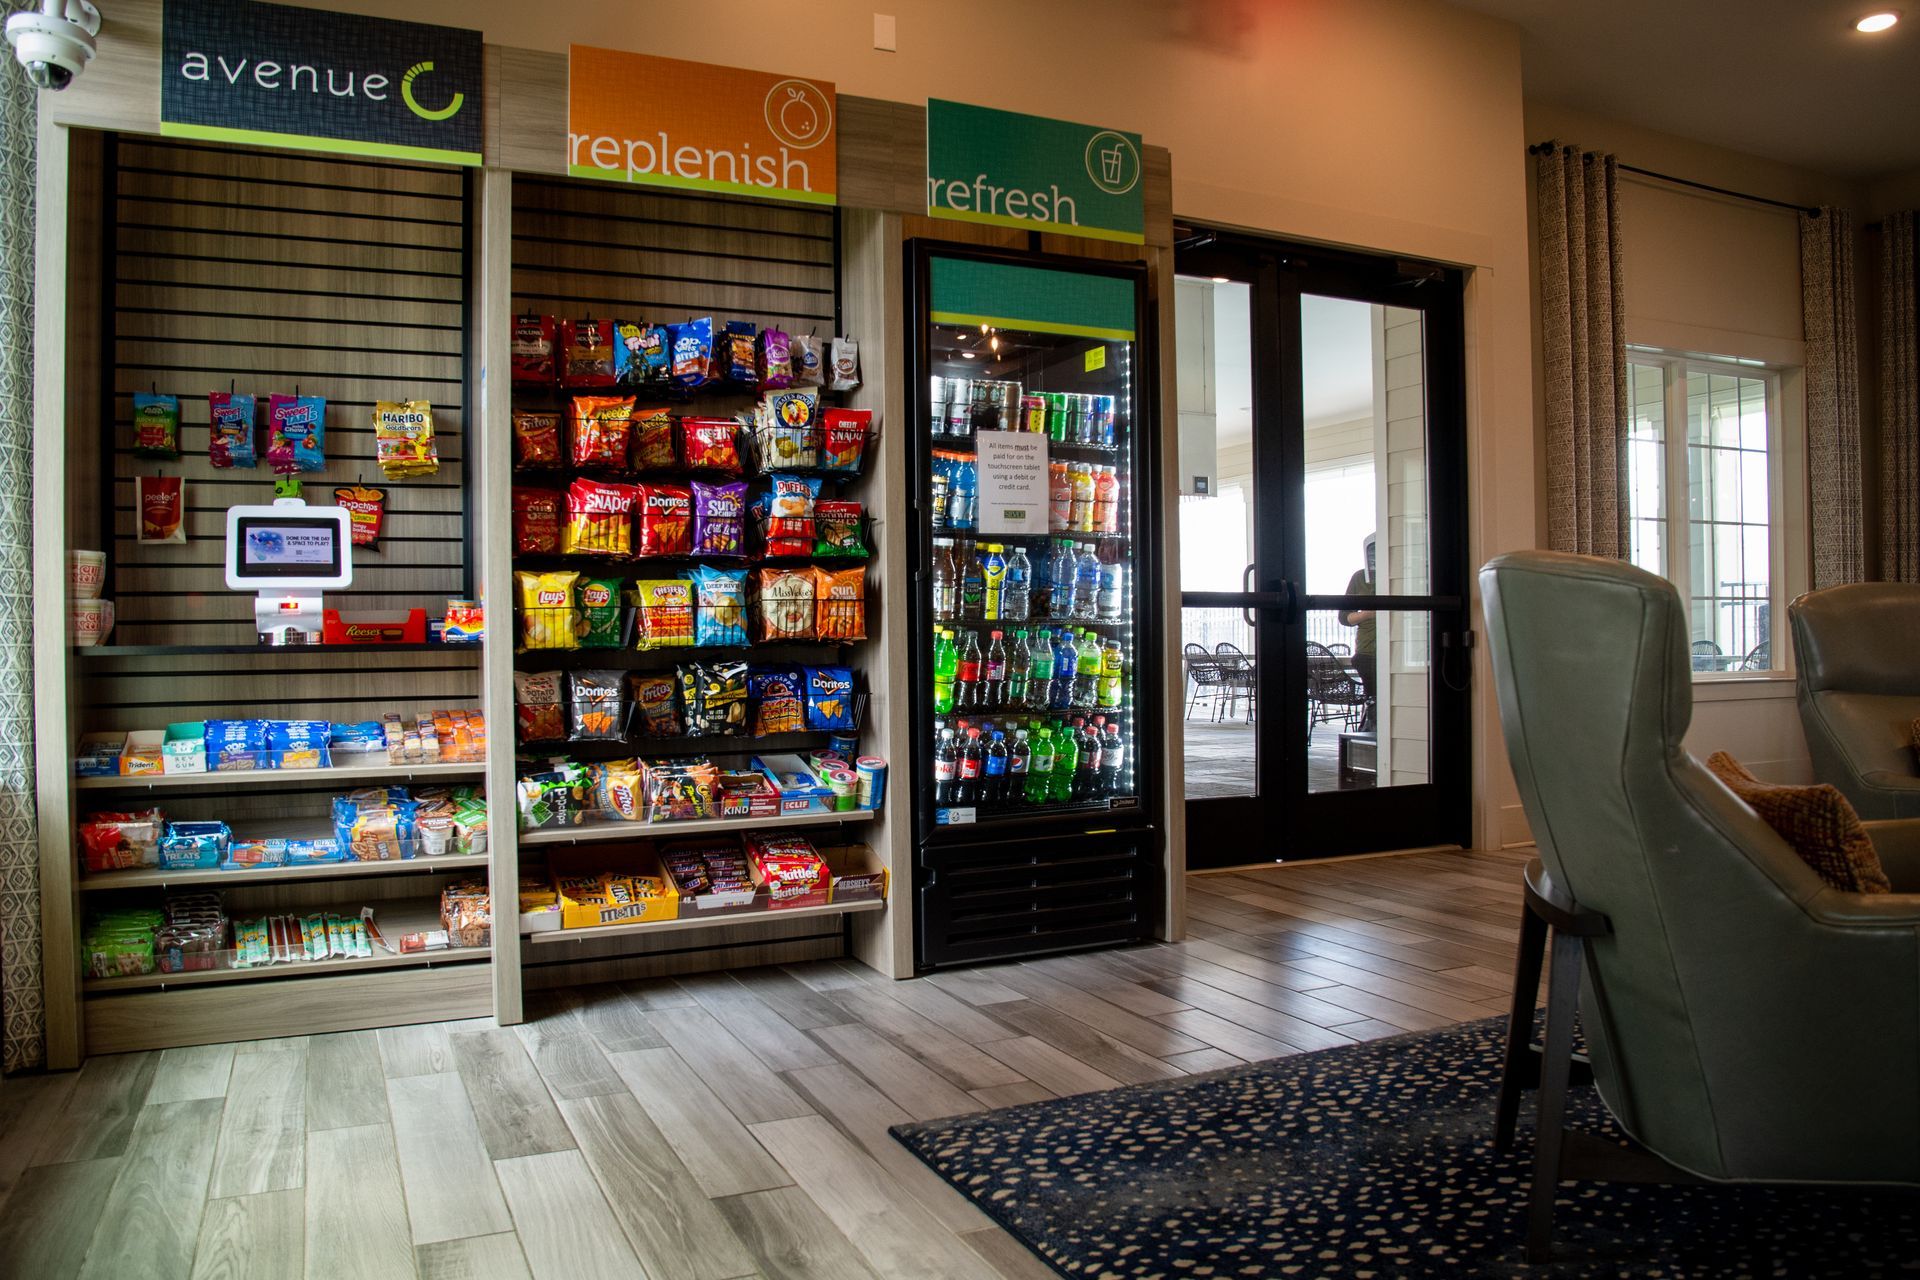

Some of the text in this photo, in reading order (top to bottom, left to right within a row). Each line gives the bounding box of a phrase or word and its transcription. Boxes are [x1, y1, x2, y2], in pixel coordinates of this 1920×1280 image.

[181, 51, 389, 101] avenue
[569, 131, 812, 193] replenish
[928, 174, 1079, 226] refresh
[383, 413, 423, 423] HARIBO
[777, 480, 811, 496] RUFFLES
[649, 496, 689, 508] Doritos
[706, 583, 722, 591] DEEP
[539, 590, 565, 605] Lay's
[812, 677, 851, 689] Doritos
[576, 686, 618, 697] Doritos
[642, 684, 671, 700] Fritos
[614, 784, 633, 815] Fritos
[789, 801, 808, 809] CLIF
[724, 806, 749, 815] KIND
[164, 852, 200, 861] TREATS
[778, 867, 818, 881] Skittles
[772, 885, 810, 900] Skittles
